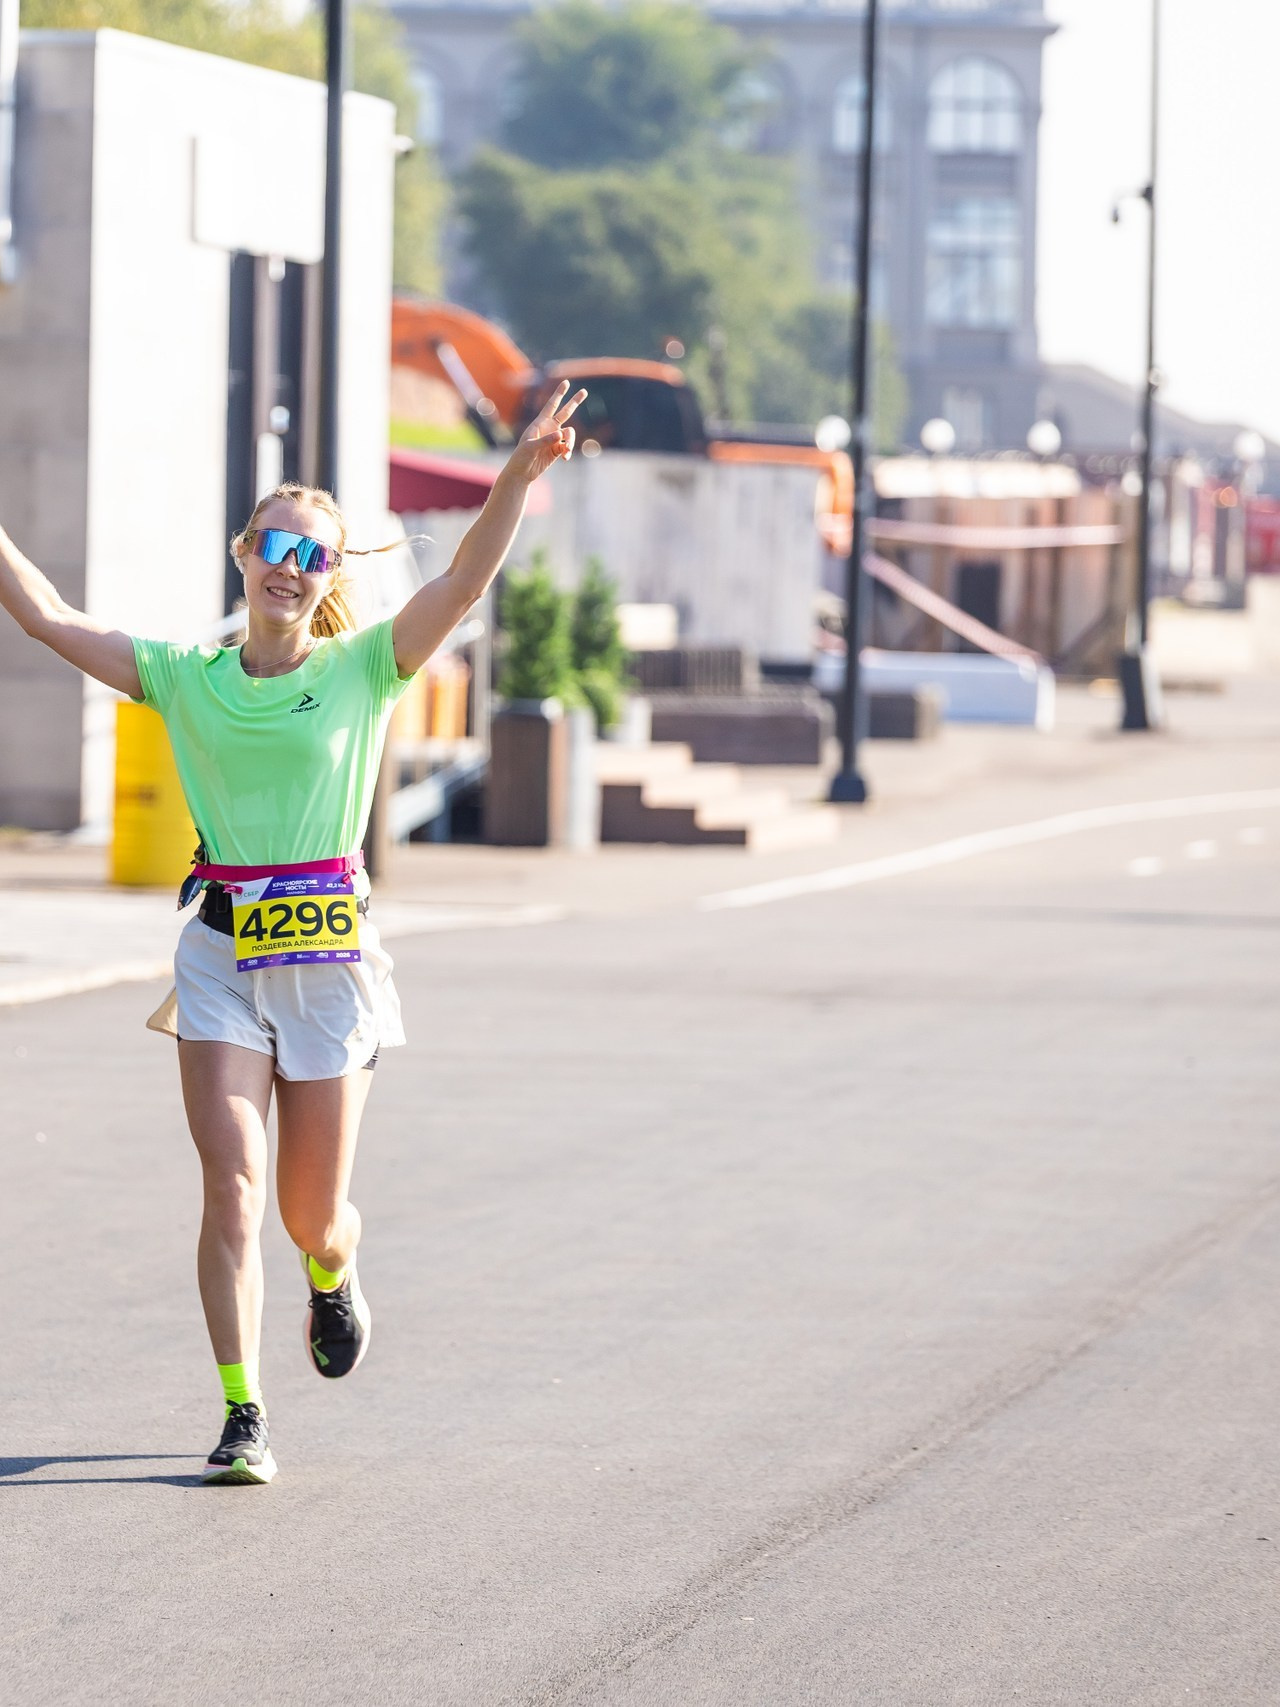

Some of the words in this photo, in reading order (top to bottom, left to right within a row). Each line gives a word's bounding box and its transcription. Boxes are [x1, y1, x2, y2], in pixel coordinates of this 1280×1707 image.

[290, 702, 320, 713] DEMIX
[272, 879, 318, 888] КРАСНОЯРСКИЕ
[243, 890, 259, 898] СБЕР
[239, 901, 353, 942] 4296
[251, 941, 293, 952] ПОЗДЕЕВА
[294, 938, 344, 947] АЛЕКСАНДРА
